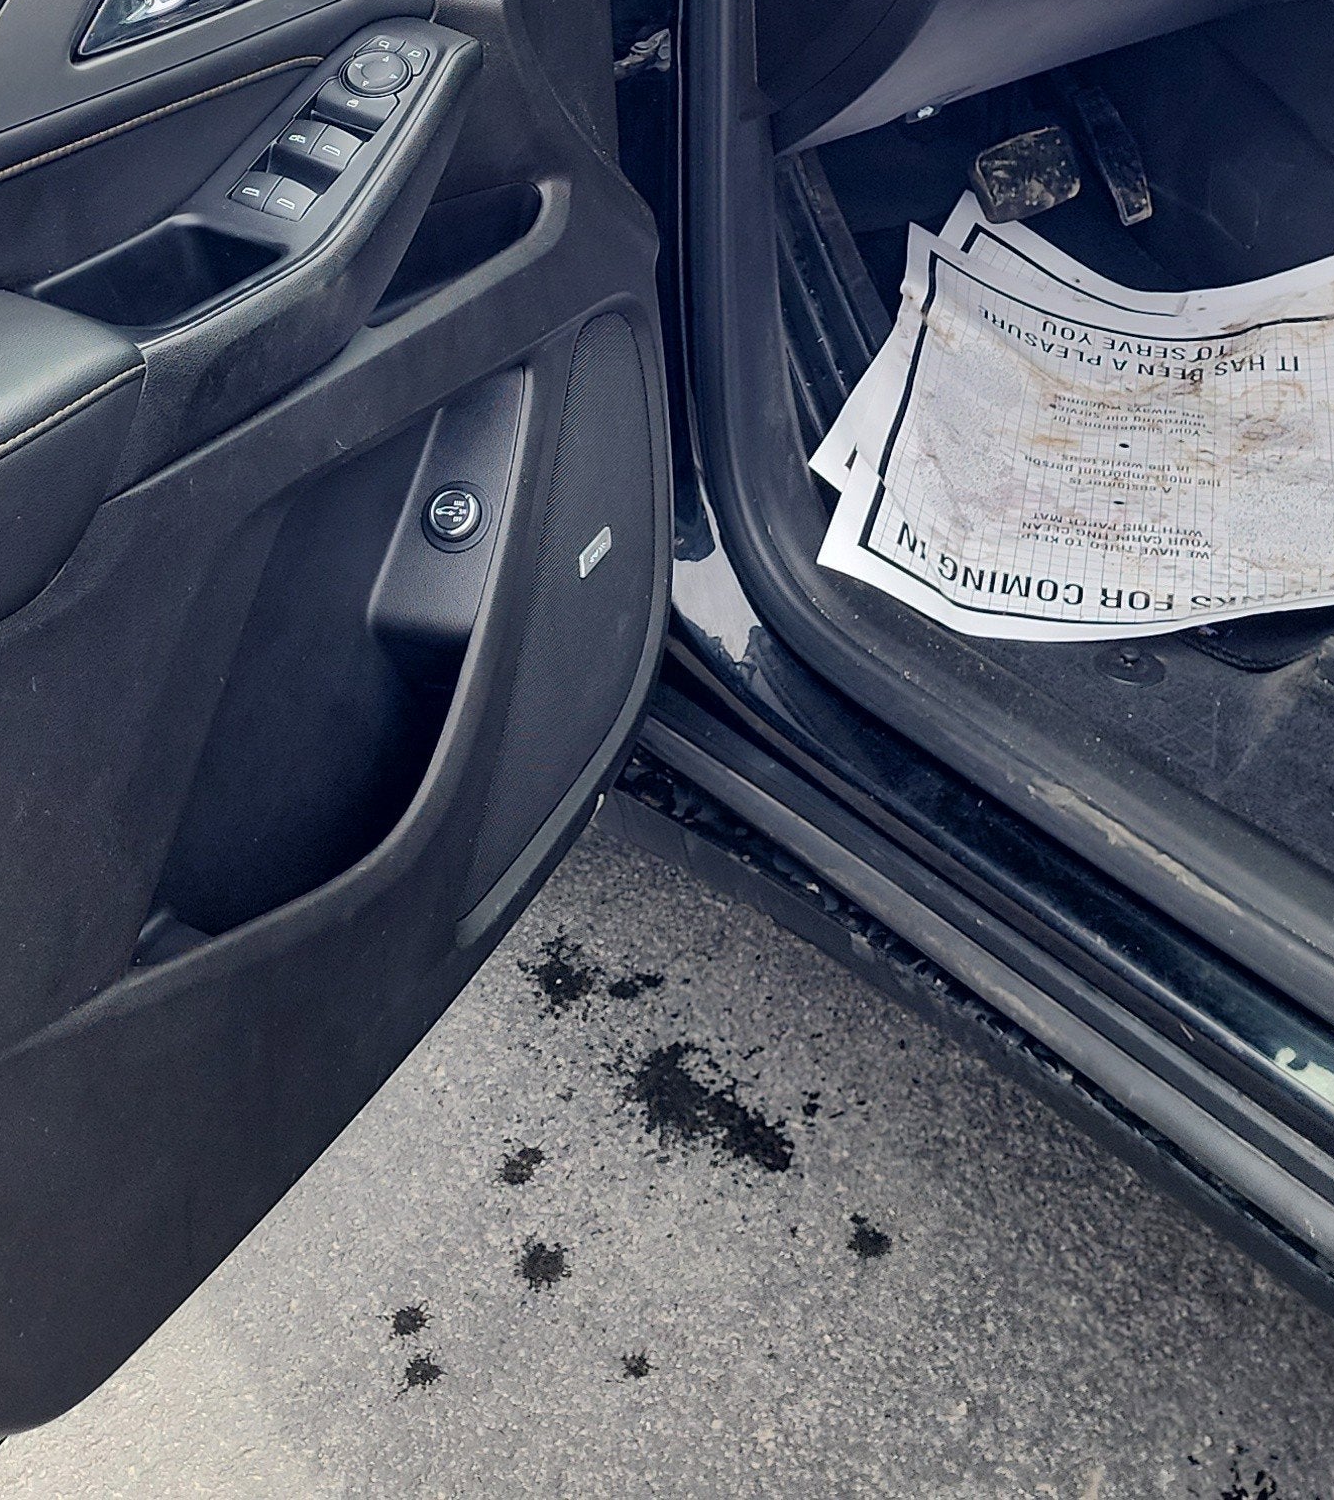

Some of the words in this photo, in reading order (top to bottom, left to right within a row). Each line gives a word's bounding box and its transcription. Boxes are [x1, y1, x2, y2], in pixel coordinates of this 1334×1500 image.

[978, 304, 1102, 367] PLEASURE
[1042, 320, 1092, 346] YOU
[1103, 336, 1186, 361] SERVE
[1196, 344, 1226, 361] TO
[1112, 357, 1128, 371] A
[1214, 354, 1265, 376] HAS
[1276, 355, 1299, 372] IT
[1137, 362, 1204, 383] BEEN
[1149, 462, 1171, 473] the
[1177, 465, 1190, 474] in
[1086, 479, 1157, 492] customer
[1198, 477, 1221, 488] the
[1162, 486, 1173, 494] A
[1032, 511, 1063, 523] MAT
[1022, 521, 1070, 535] CLEAN
[1123, 522, 1156, 534] THIS
[1163, 525, 1203, 537] WITH
[897, 521, 927, 561] IN
[1064, 536, 1082, 547] TO
[1169, 537, 1212, 549] YOUR
[938, 553, 1084, 605] COMING
[1100, 587, 1174, 612] FOR
